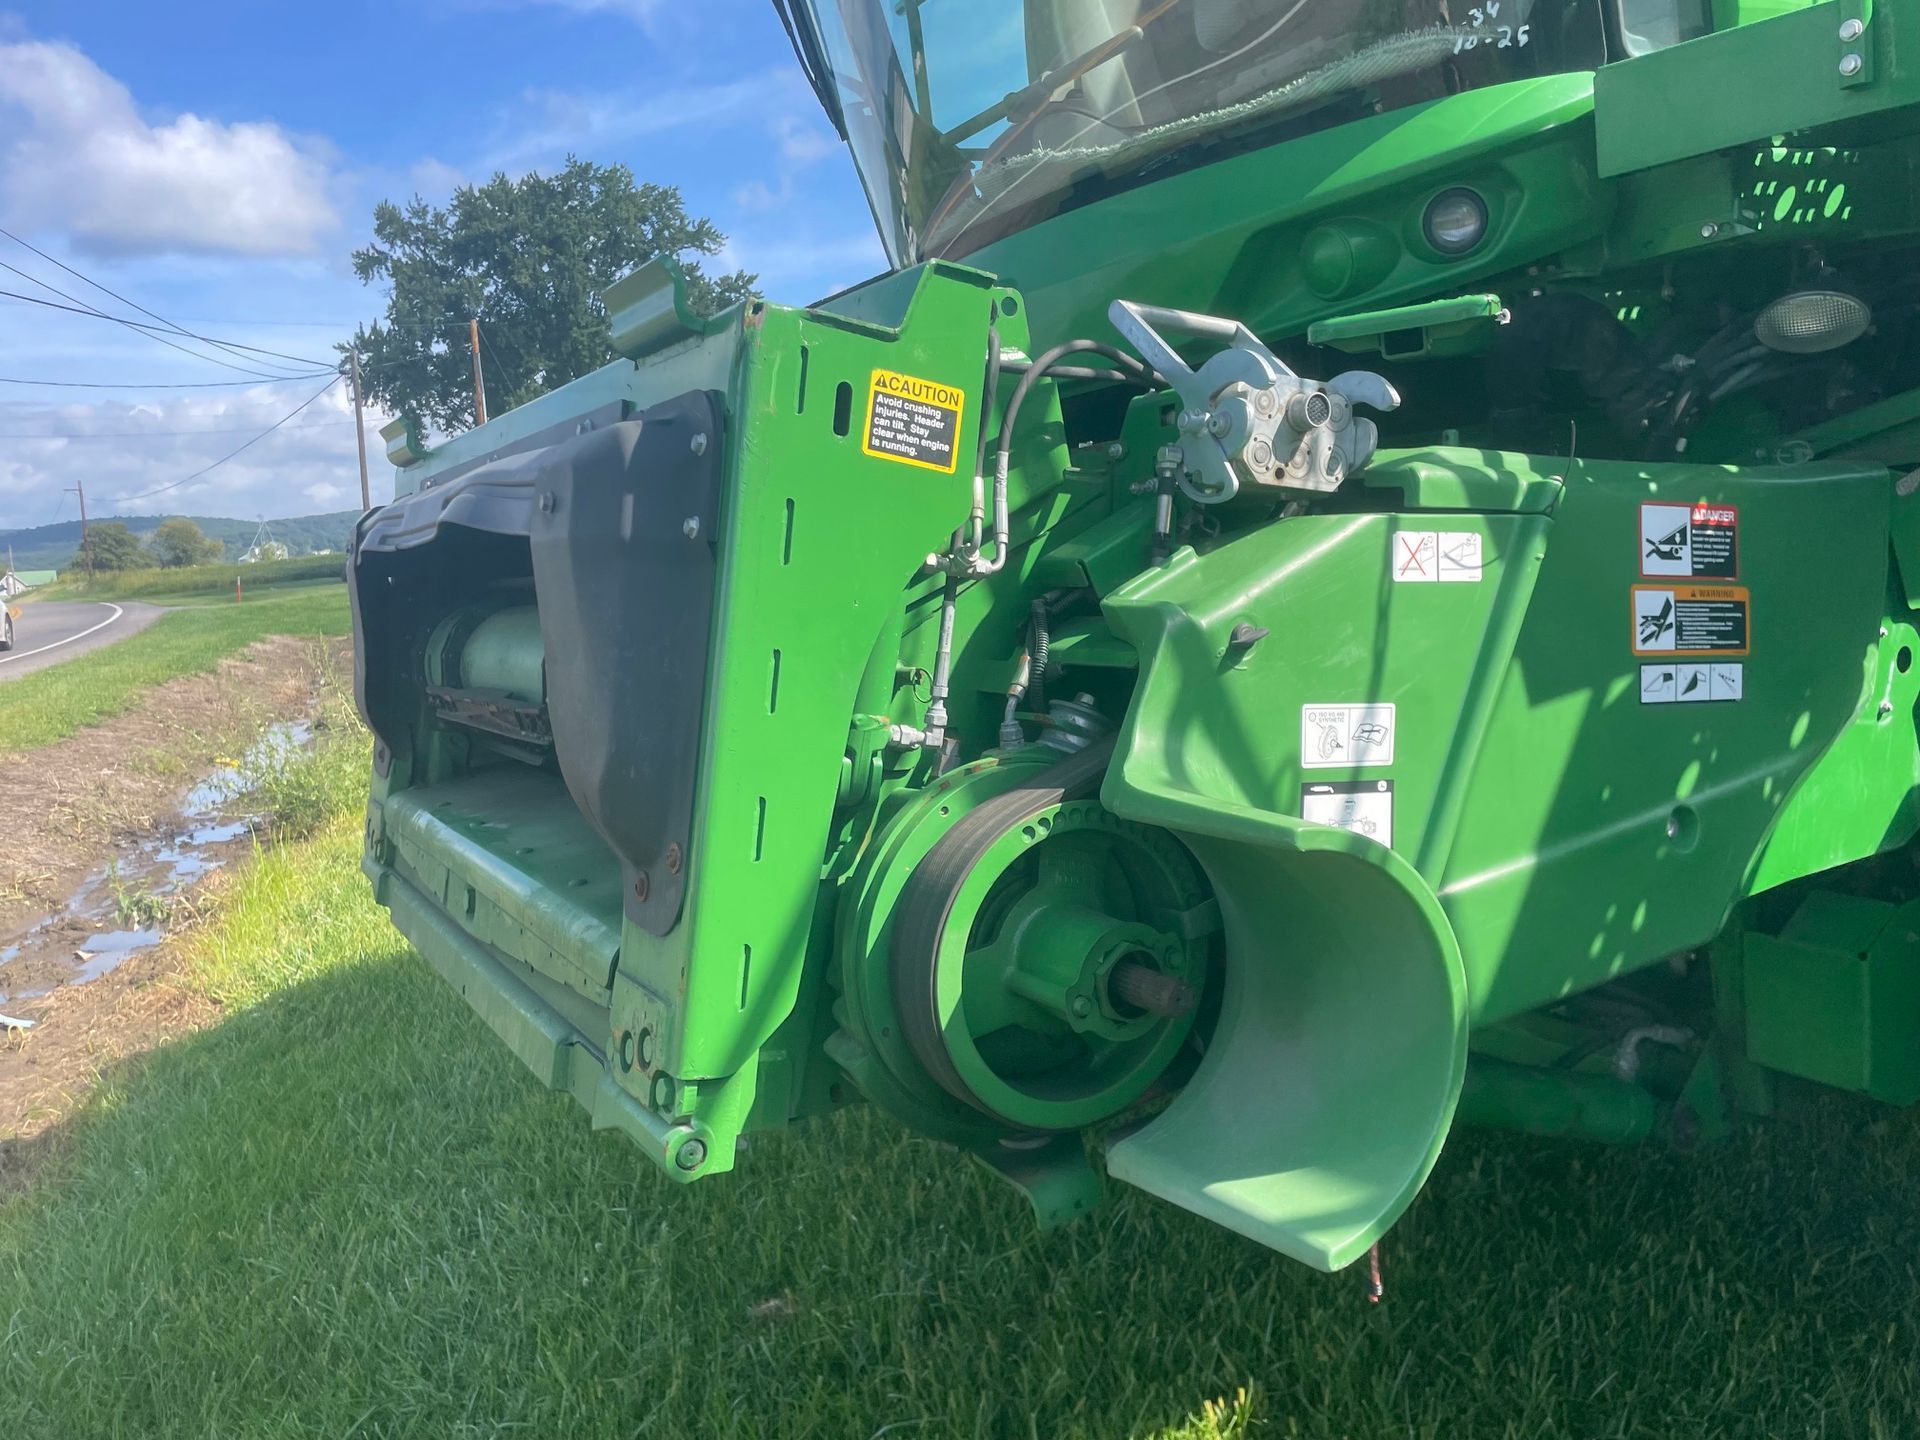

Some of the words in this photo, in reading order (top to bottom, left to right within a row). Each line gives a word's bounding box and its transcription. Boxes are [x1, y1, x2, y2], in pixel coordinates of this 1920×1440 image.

[889, 376, 960, 406] CAUTION
[876, 394, 903, 408] Avoid
[903, 402, 942, 419] crushing
[873, 417, 890, 427] can
[892, 419, 906, 431] tilt.
[910, 424, 930, 438] Stay
[914, 414, 945, 429] Header
[871, 436, 880, 446] is
[882, 440, 918, 456] running.
[872, 426, 895, 439] clear
[896, 432, 920, 445] when
[920, 440, 950, 452] engine
[1700, 509, 1734, 522] DANGER
[1699, 589, 1735, 598] WARNING
